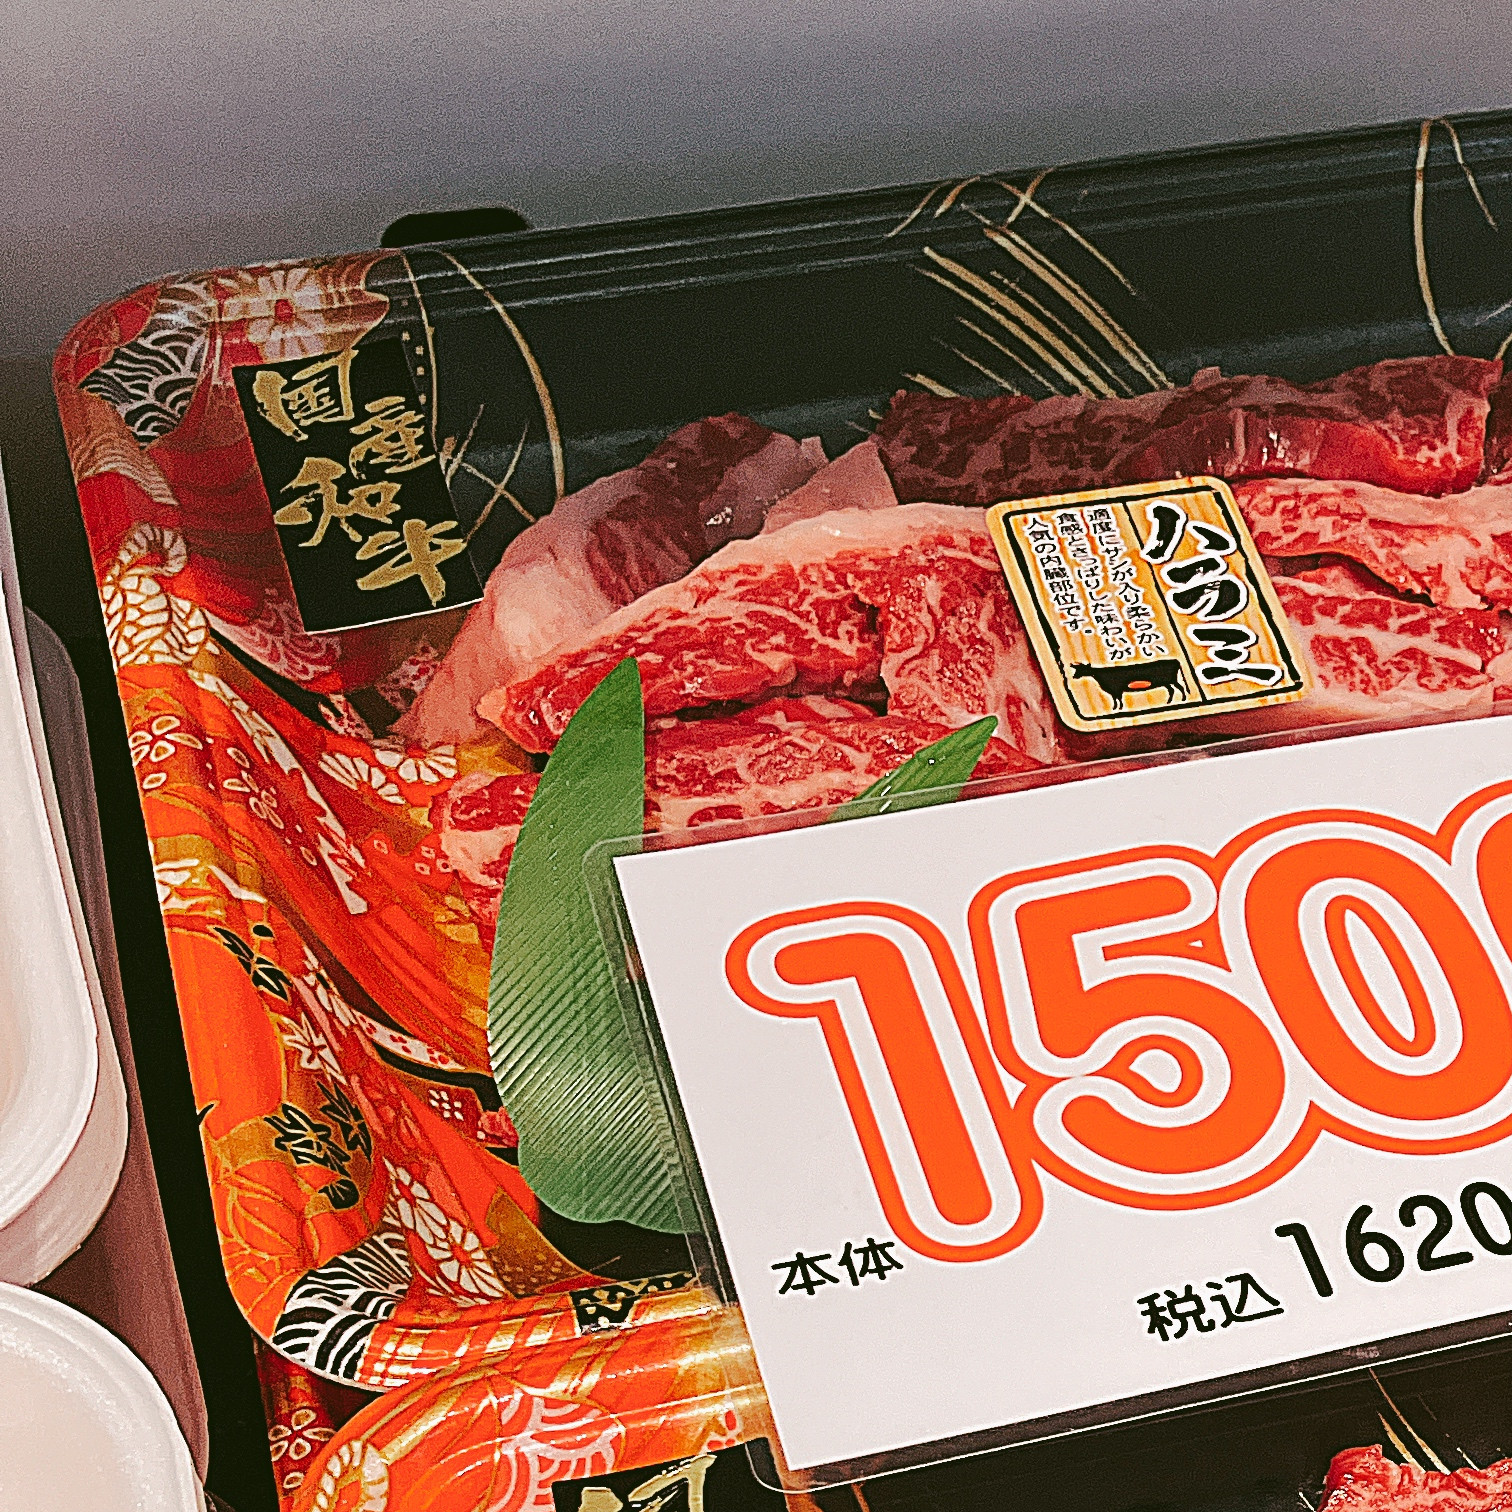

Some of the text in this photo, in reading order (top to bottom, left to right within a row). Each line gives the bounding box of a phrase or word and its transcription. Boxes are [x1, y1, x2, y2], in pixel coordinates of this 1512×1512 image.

[252, 350, 467, 606] 国産和牛
[1057, 513, 1132, 661] 食感とさっぱりした味わいが
[1088, 508, 1165, 657] 適度にサシが入り柔らかい
[1145, 504, 1280, 683] ハラミ
[770, 1237, 904, 1298] 本体
[1136, 1273, 1284, 1342] 税込
